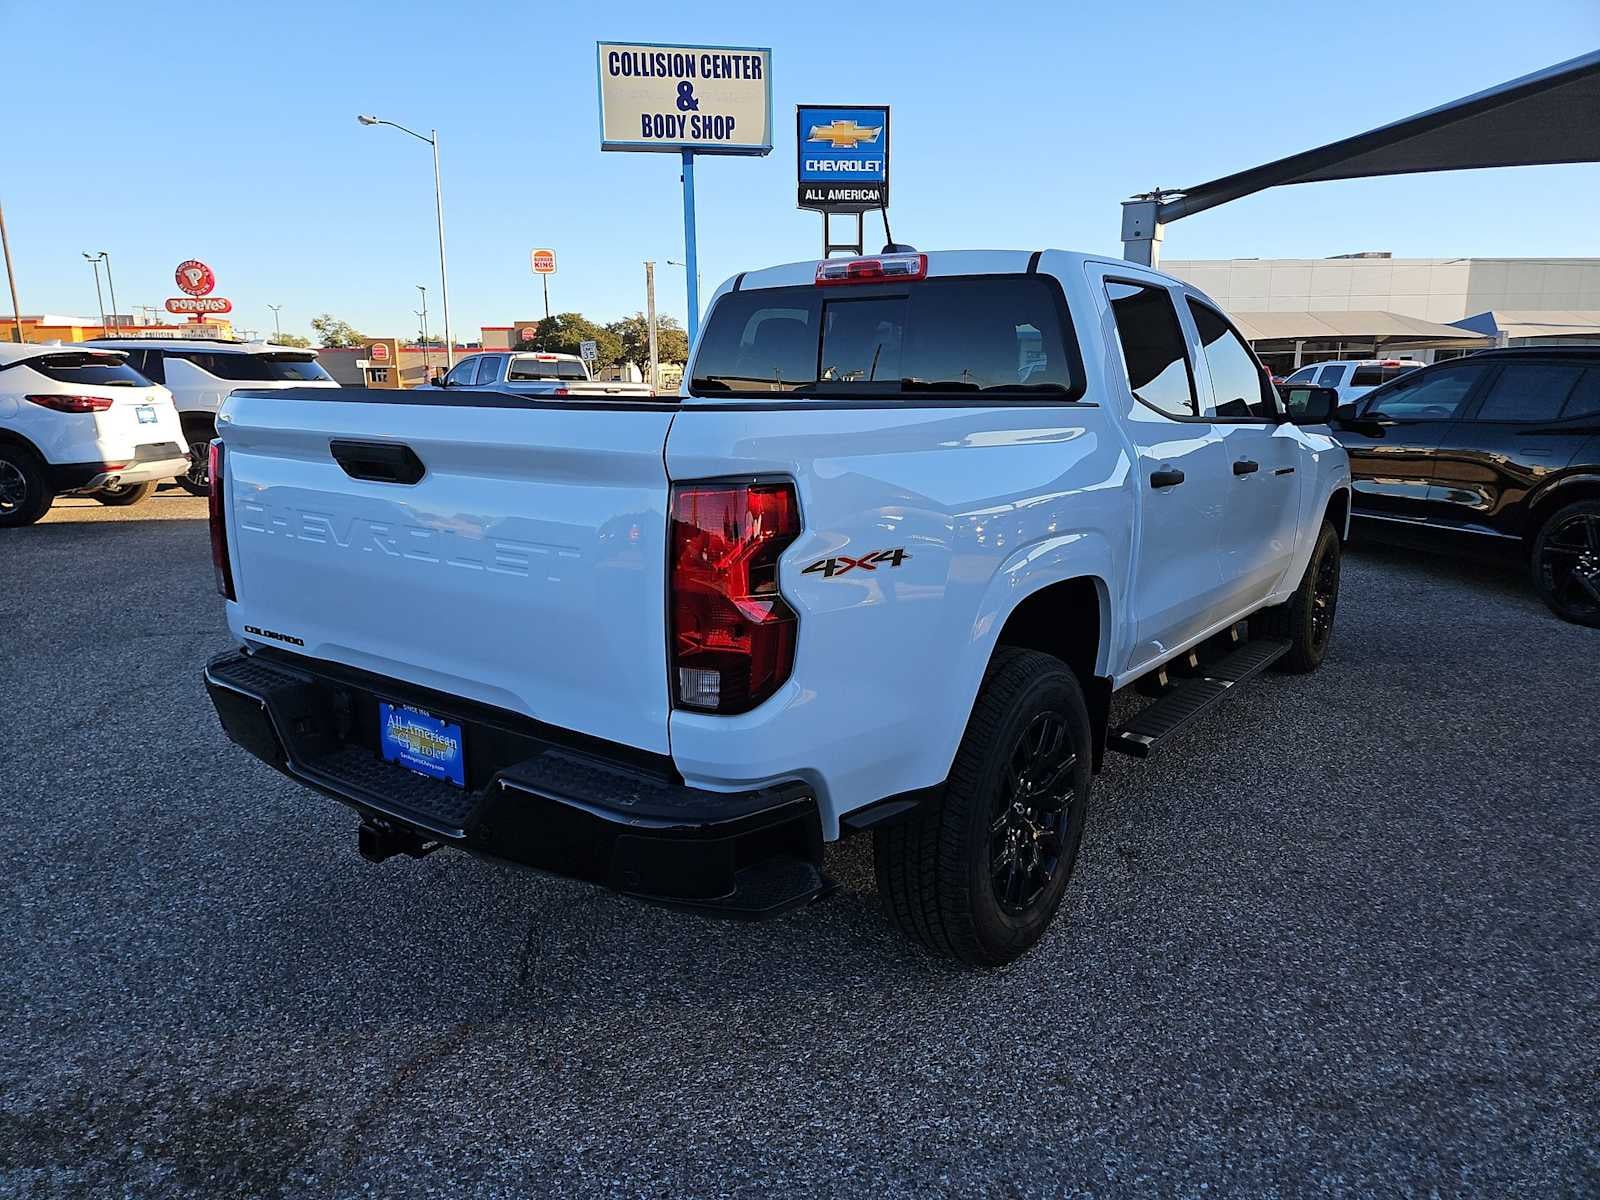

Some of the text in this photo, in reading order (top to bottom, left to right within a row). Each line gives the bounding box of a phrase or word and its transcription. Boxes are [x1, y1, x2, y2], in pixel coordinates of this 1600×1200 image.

[608, 51, 762, 80] COLLISION CENTER
[676, 80, 699, 111] &
[641, 114, 735, 139] BODY SHOP
[805, 159, 881, 172] CHEVROLET
[805, 189, 880, 201] ALL AMERICAN
[183, 268, 203, 287] P
[583, 351, 596, 360] 35
[239, 499, 581, 583] CHEVROLET
[244, 625, 305, 647] COLORADO
[387, 714, 457, 749] All American
